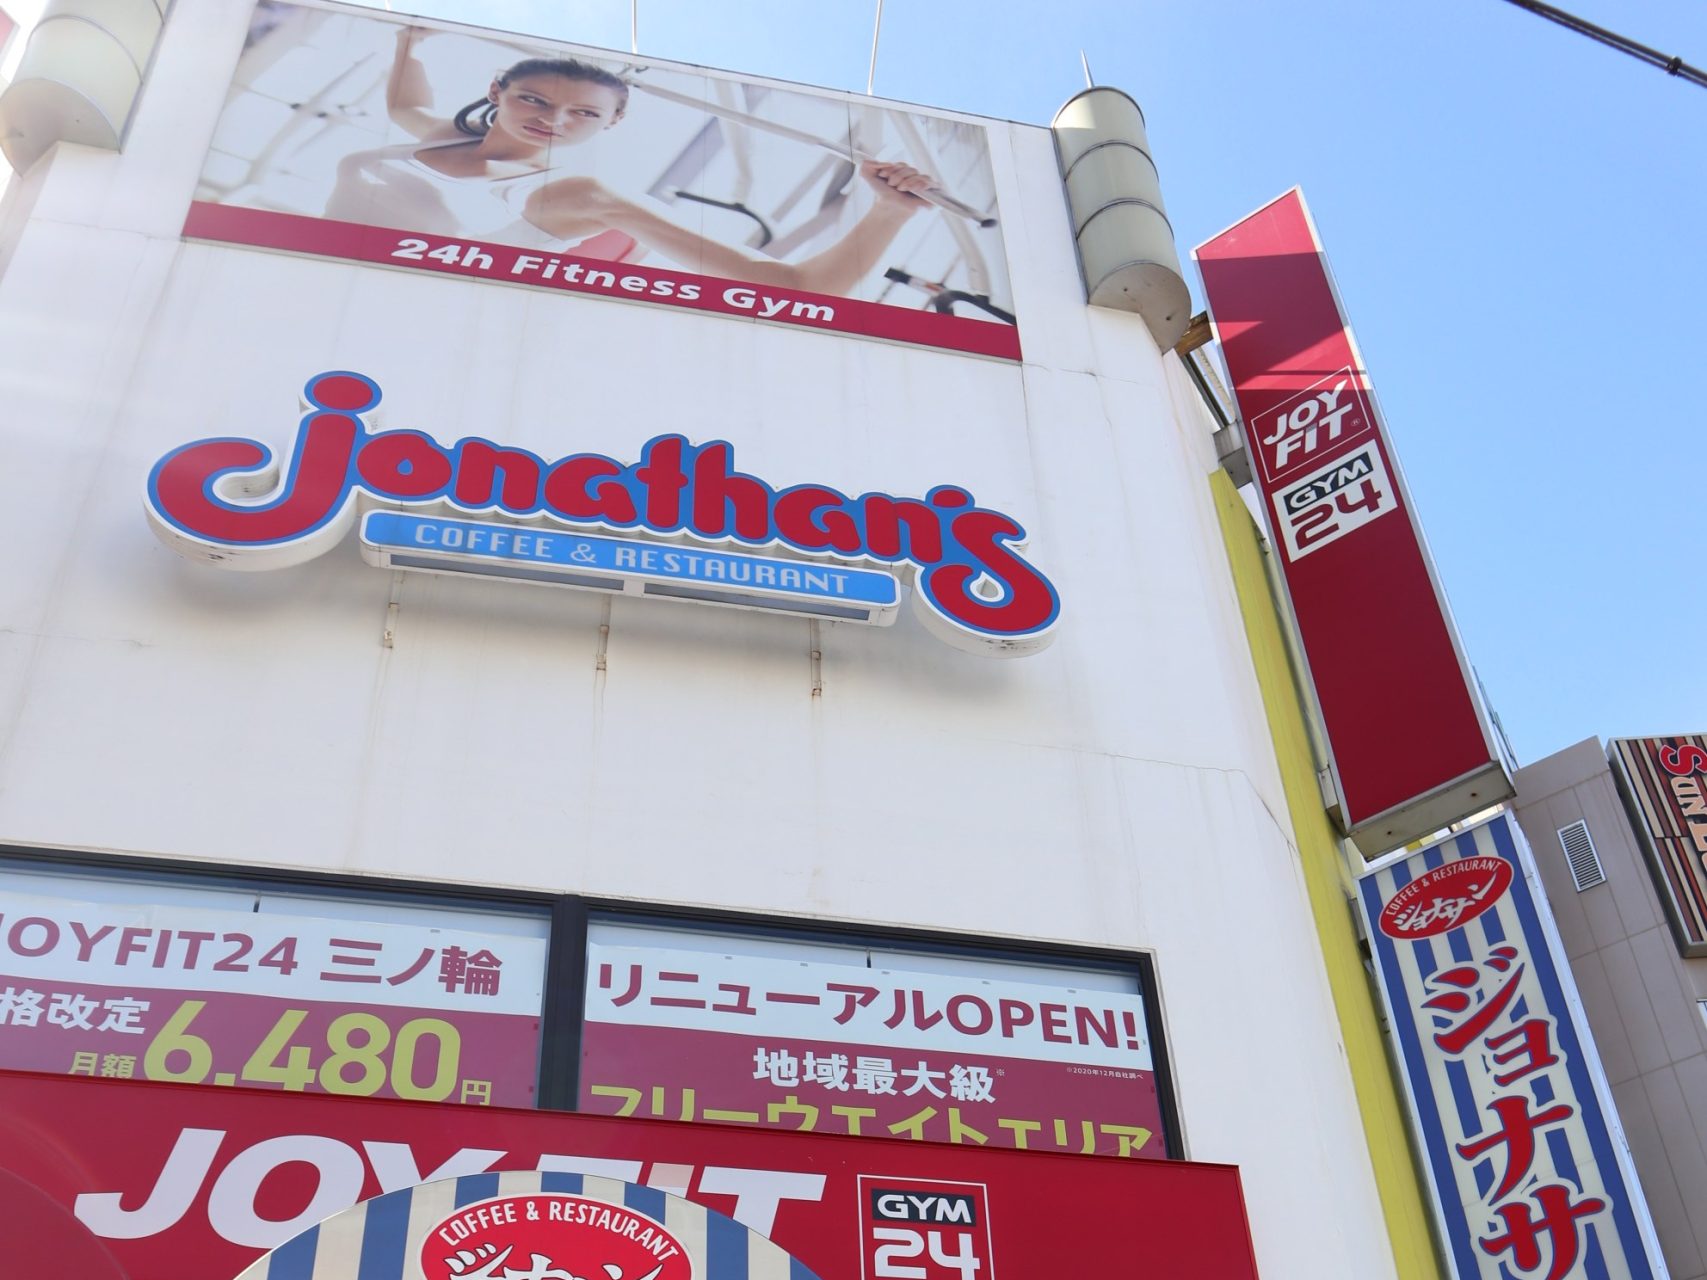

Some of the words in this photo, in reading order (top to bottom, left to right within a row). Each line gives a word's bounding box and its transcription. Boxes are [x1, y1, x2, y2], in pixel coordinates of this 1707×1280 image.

[391, 238, 493, 273] 24h
[511, 253, 702, 301] Fitness
[723, 287, 836, 324] Gym
[1263, 379, 1348, 445] JOY
[1275, 403, 1353, 469] FIT
[1290, 458, 1370, 508] GYM
[1291, 479, 1382, 550] 24
[415, 523, 552, 561] COFFEE
[571, 543, 595, 564] &
[614, 548, 849, 595] RESTAURANT
[1386, 884, 1420, 915] COFFEE
[1421, 878, 1431, 887] &
[1432, 859, 1502, 882] RESTAURANT
[1393, 872, 1497, 931] ジョナサン
[0, 912, 298, 976] OYFIT24
[320, 937, 503, 997] 三ノ輪
[0, 986, 150, 1035] 格改定
[599, 963, 1139, 1050] リニューアルOPEN!
[438, 1202, 517, 1247] COFFEE
[527, 1203, 540, 1219] &
[549, 1202, 679, 1263] RESTAURANT
[876, 1193, 974, 1224] GYM
